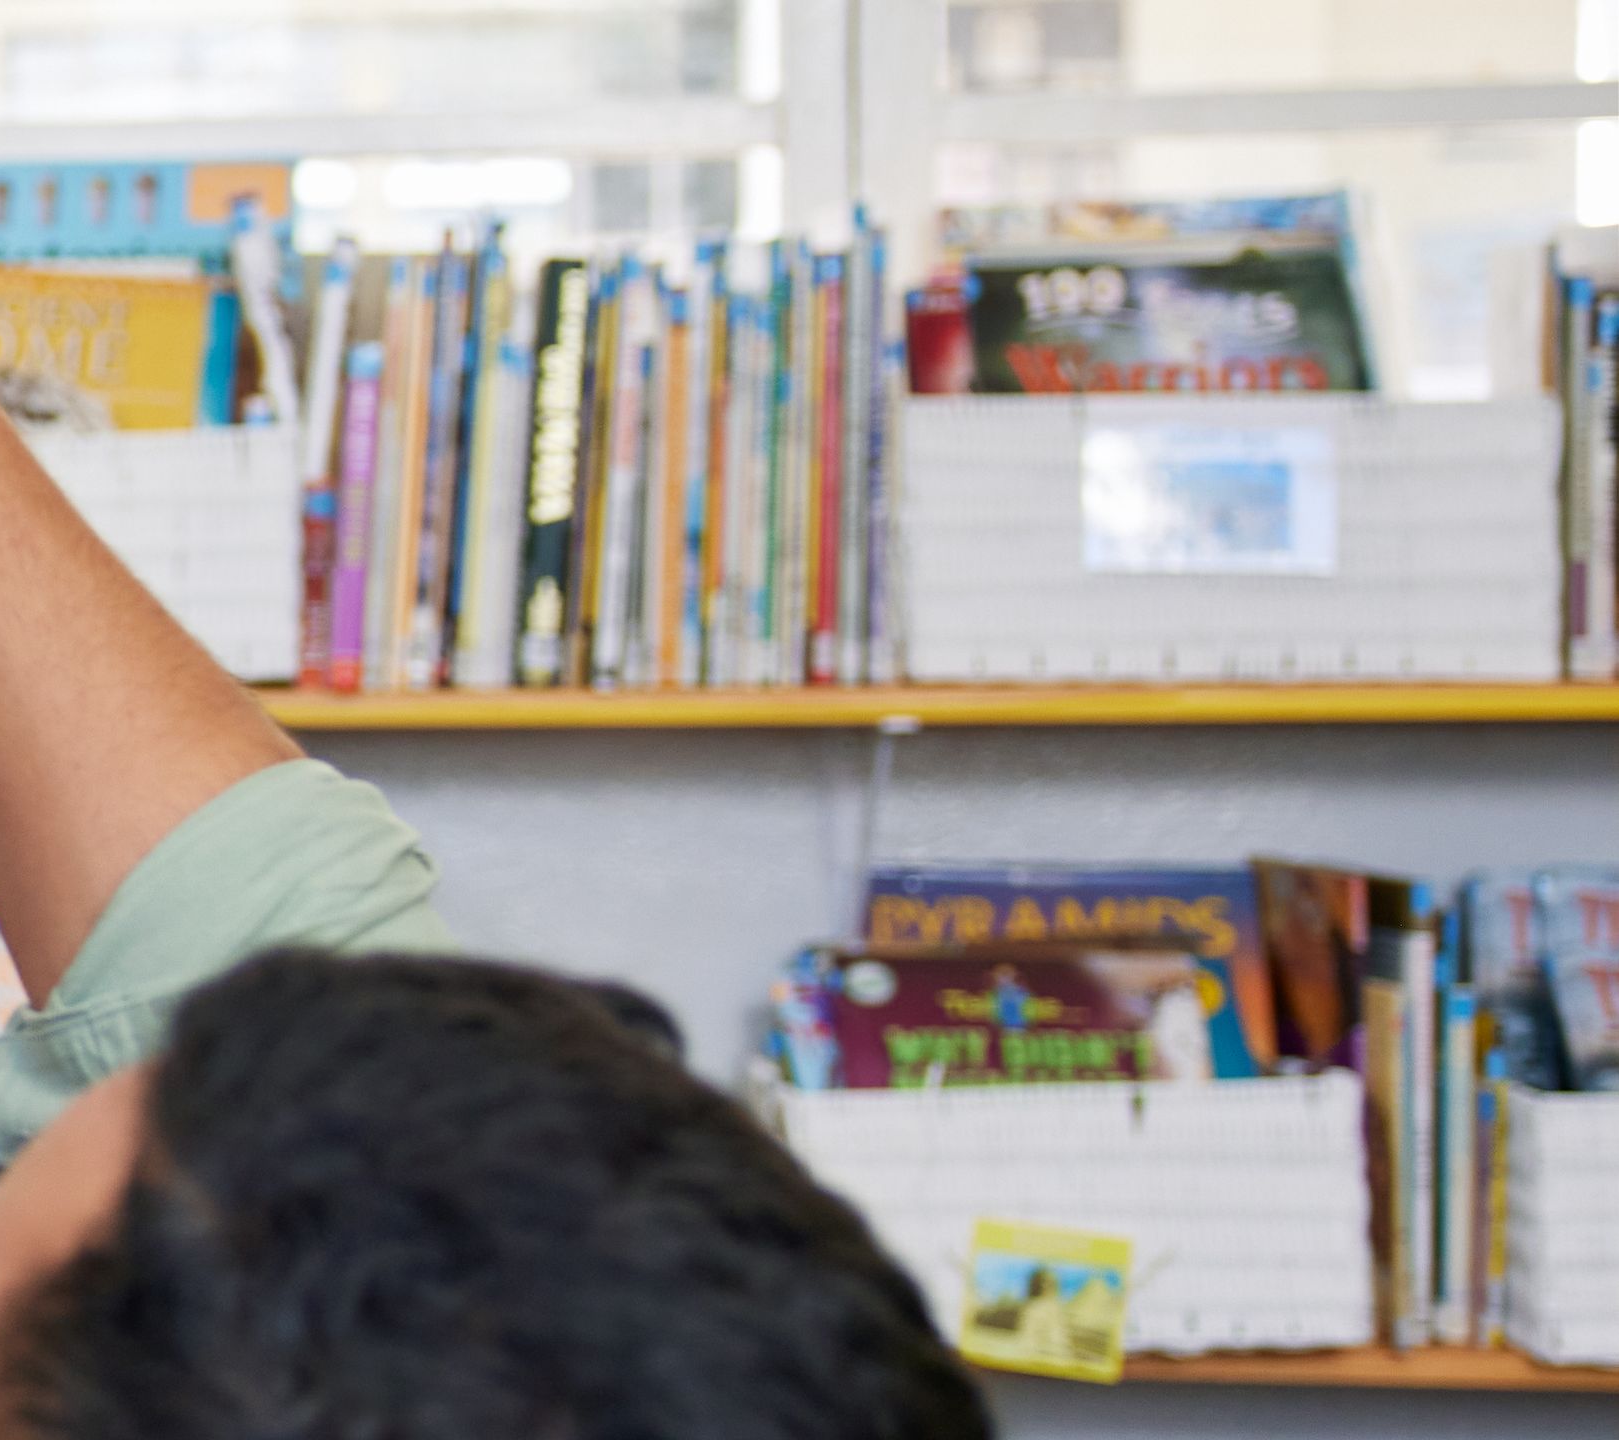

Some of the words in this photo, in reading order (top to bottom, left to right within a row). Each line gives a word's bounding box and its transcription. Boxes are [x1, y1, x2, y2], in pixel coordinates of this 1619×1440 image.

[1018, 266, 1127, 321] 100
[1004, 340, 1330, 391] Warriors
[869, 893, 1239, 958] PYRAMIDS
